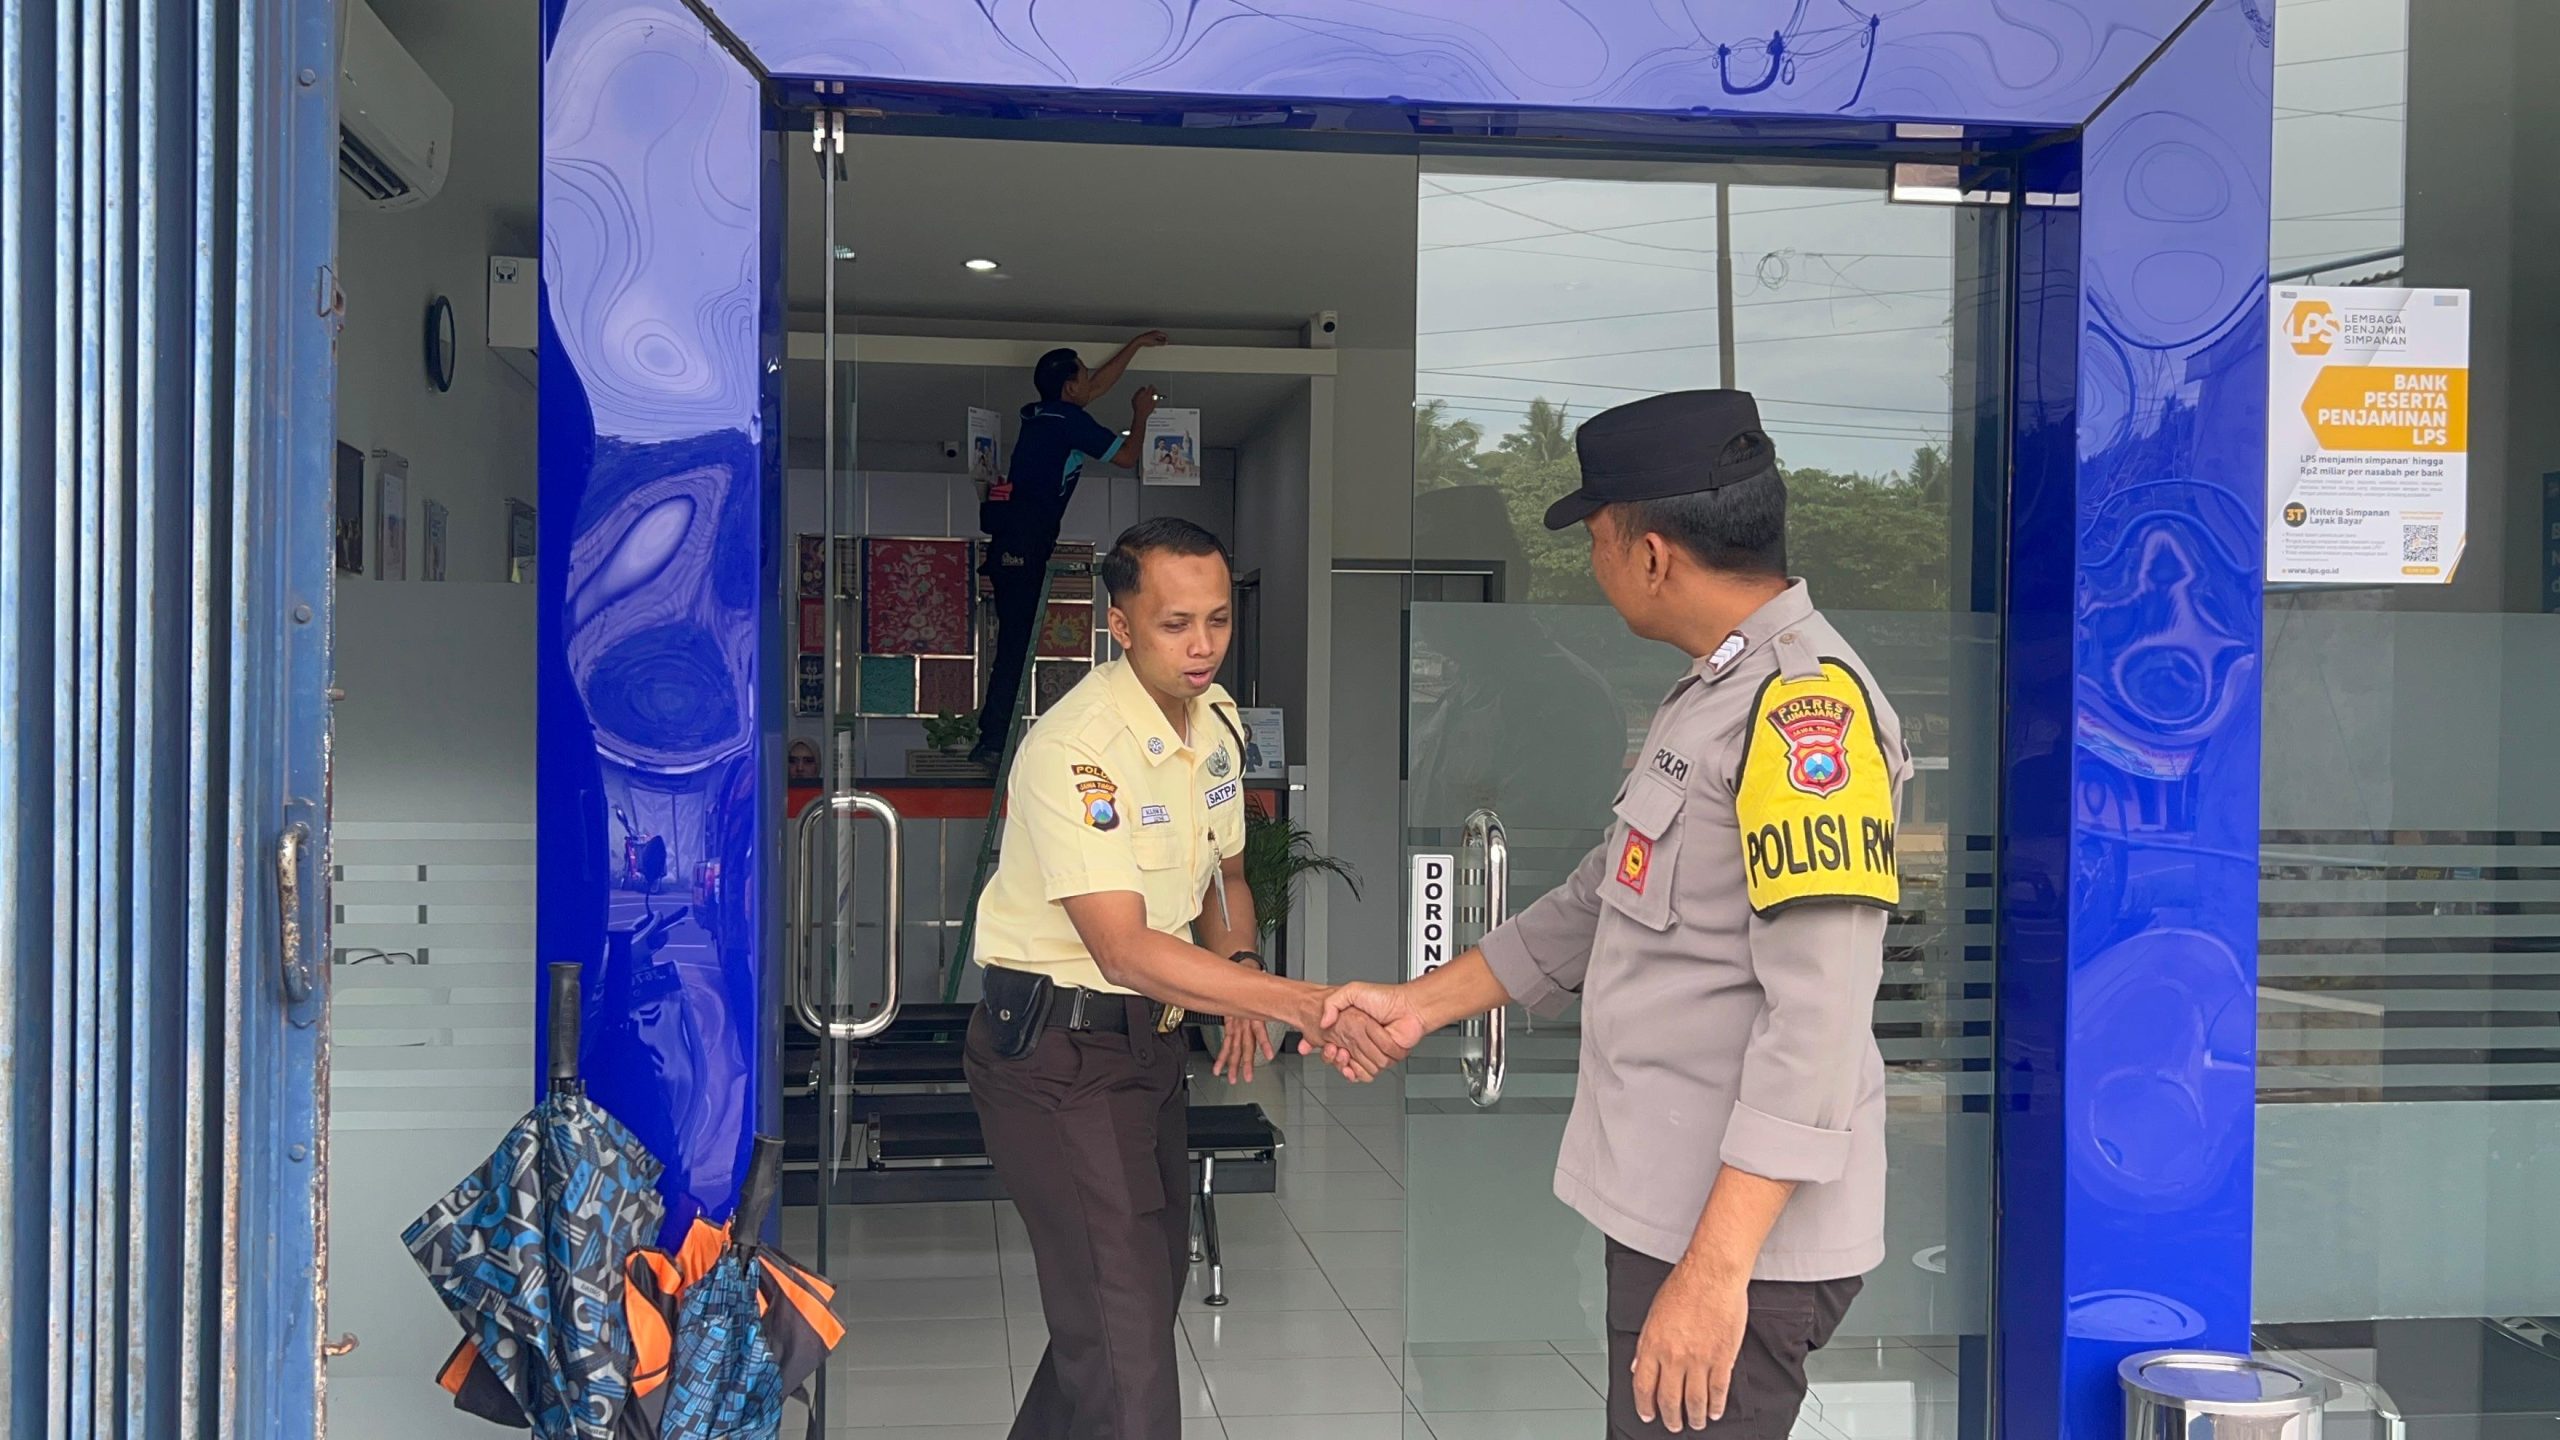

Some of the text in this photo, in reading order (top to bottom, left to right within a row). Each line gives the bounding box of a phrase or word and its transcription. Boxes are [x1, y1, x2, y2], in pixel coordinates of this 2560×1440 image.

[2344, 314, 2401, 324] LEMBAGA
[2286, 312, 2341, 344] LPS
[2344, 325, 2406, 335] PENJAMIN
[2344, 335, 2407, 345] SIMPANAN
[2394, 374, 2447, 391] BANK
[2364, 392, 2447, 409] PESERTA
[2318, 409, 2447, 427] PENJAMINAN
[2412, 429, 2447, 446] LPS
[2300, 455, 2317, 463] LPS
[2319, 456, 2363, 465] menjamin
[2412, 456, 2444, 467] hingga
[2300, 466, 2443, 478] Rp2 miliar per nasabah per bank
[2287, 508, 2304, 521] 3T
[2310, 507, 2344, 516] Kriteria
[2346, 508, 2390, 518] Simpanan
[2309, 517, 2363, 526] Layak Bayar
[1778, 699, 1843, 718] POLRES
[1782, 708, 1841, 724] LUMAJANG
[1652, 748, 1689, 782] POLRI
[1208, 783, 1237, 804] SATPA
[1747, 814, 1895, 889] POLISI RW
